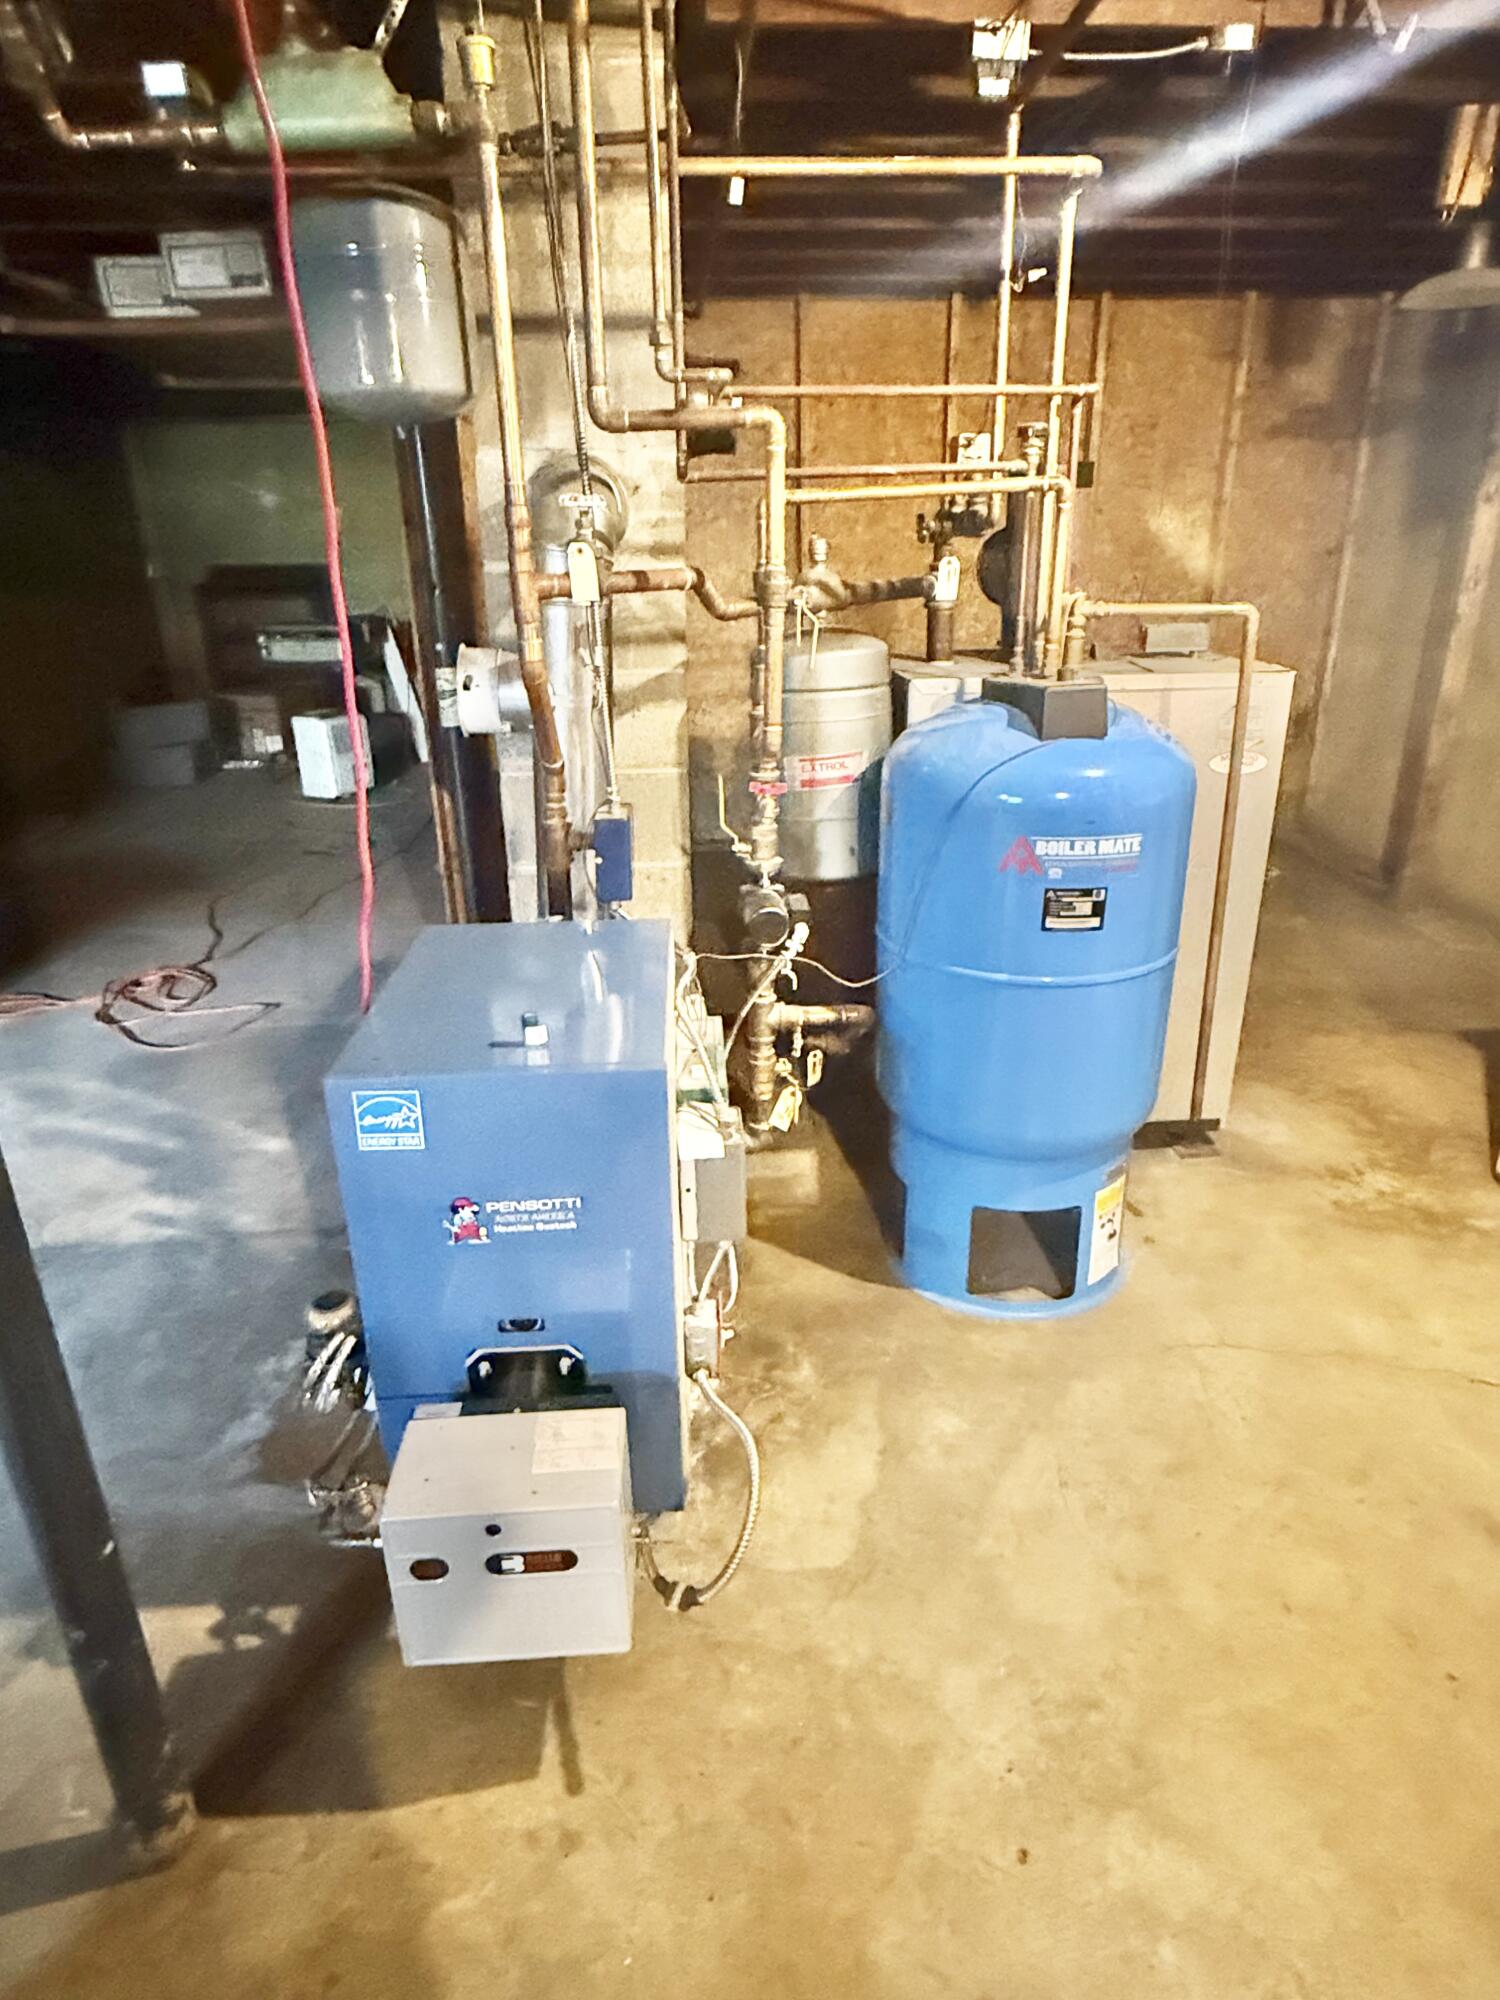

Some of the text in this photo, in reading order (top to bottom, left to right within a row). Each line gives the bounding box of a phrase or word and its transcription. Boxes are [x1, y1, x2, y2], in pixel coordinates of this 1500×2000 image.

[801, 761, 848, 774] EXTROL
[1035, 837, 1142, 856] BOILER MATE
[485, 1197, 582, 1214] PENSOTTI
